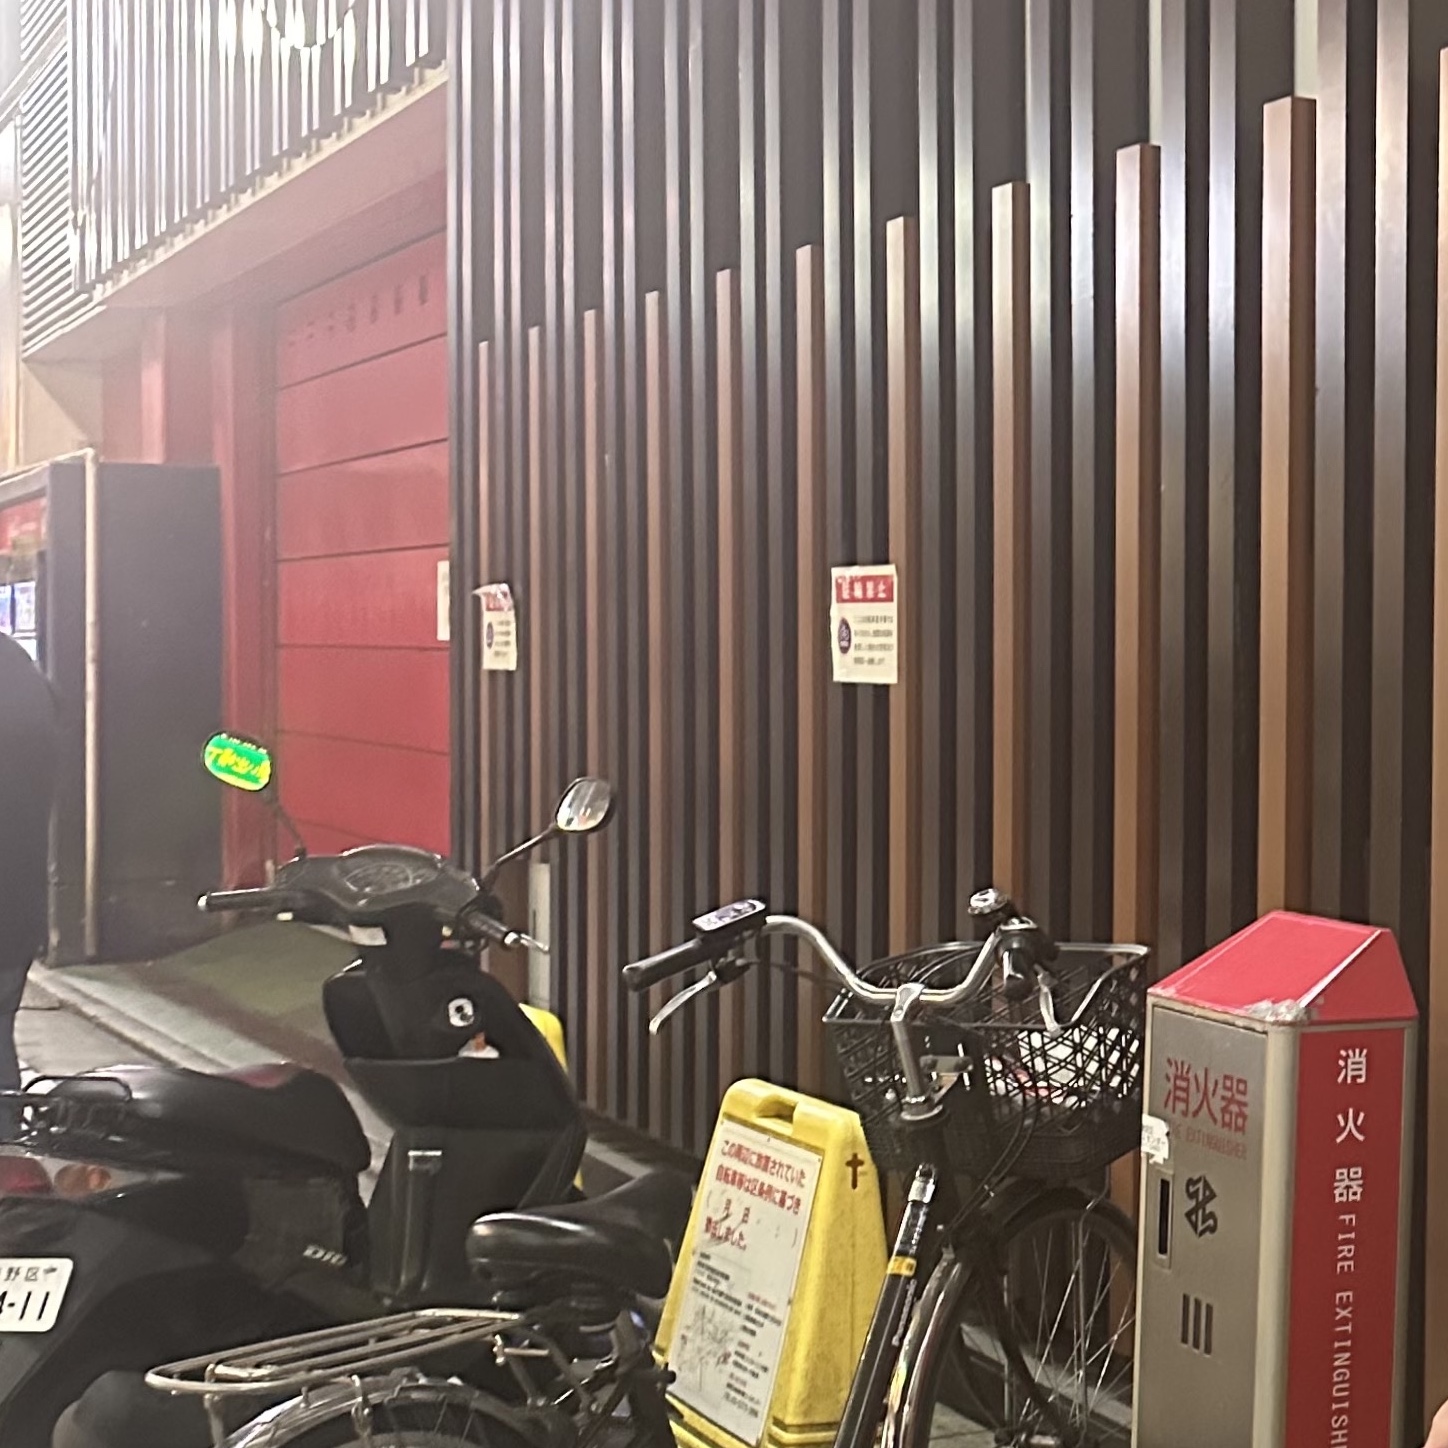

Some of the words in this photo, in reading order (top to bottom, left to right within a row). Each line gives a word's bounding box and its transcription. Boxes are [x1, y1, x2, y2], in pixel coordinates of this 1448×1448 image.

[1164, 1056, 1248, 1136] 消火器
[1333, 1048, 1368, 1202] 消火器
[1336, 1213, 1356, 1275] FIRE
